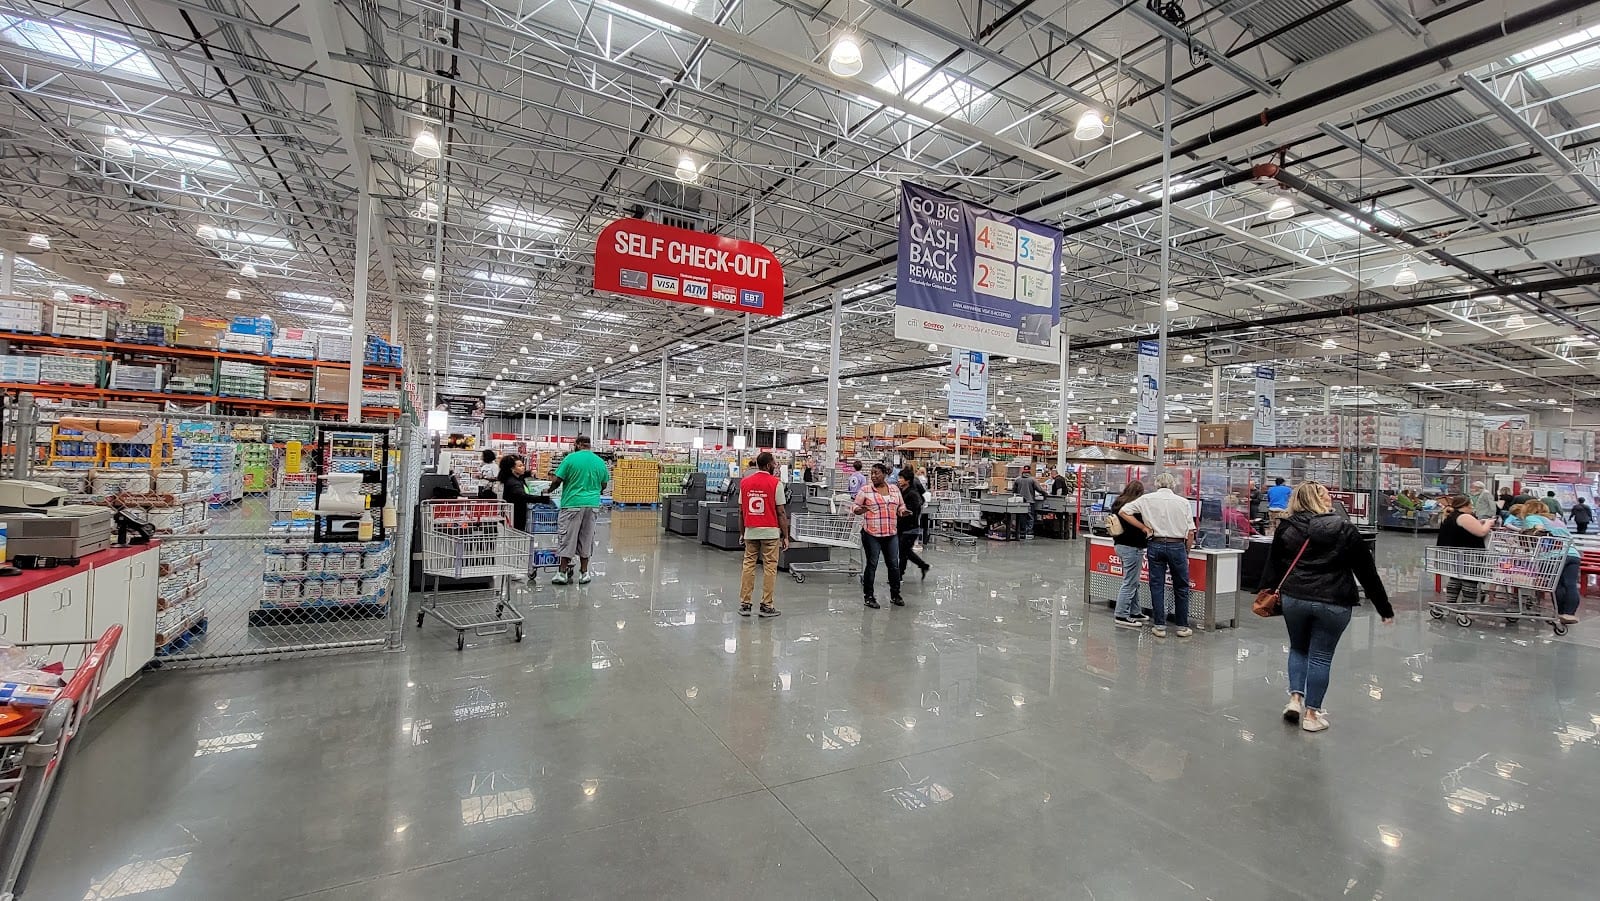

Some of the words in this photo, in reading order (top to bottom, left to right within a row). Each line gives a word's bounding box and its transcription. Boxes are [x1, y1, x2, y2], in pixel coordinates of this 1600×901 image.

[911, 196, 934, 215] GO
[937, 203, 959, 223] BIG
[928, 217, 943, 227] WITH
[910, 222, 959, 252] CASH
[614, 230, 664, 260] SELF
[668, 241, 771, 280] CHECK-OUT
[910, 242, 958, 273] BACK
[909, 263, 957, 286] REWARDS
[656, 279, 676, 290] VISA
[684, 283, 707, 296] ATM
[712, 290, 737, 304] shop
[744, 293, 760, 303] EBT
